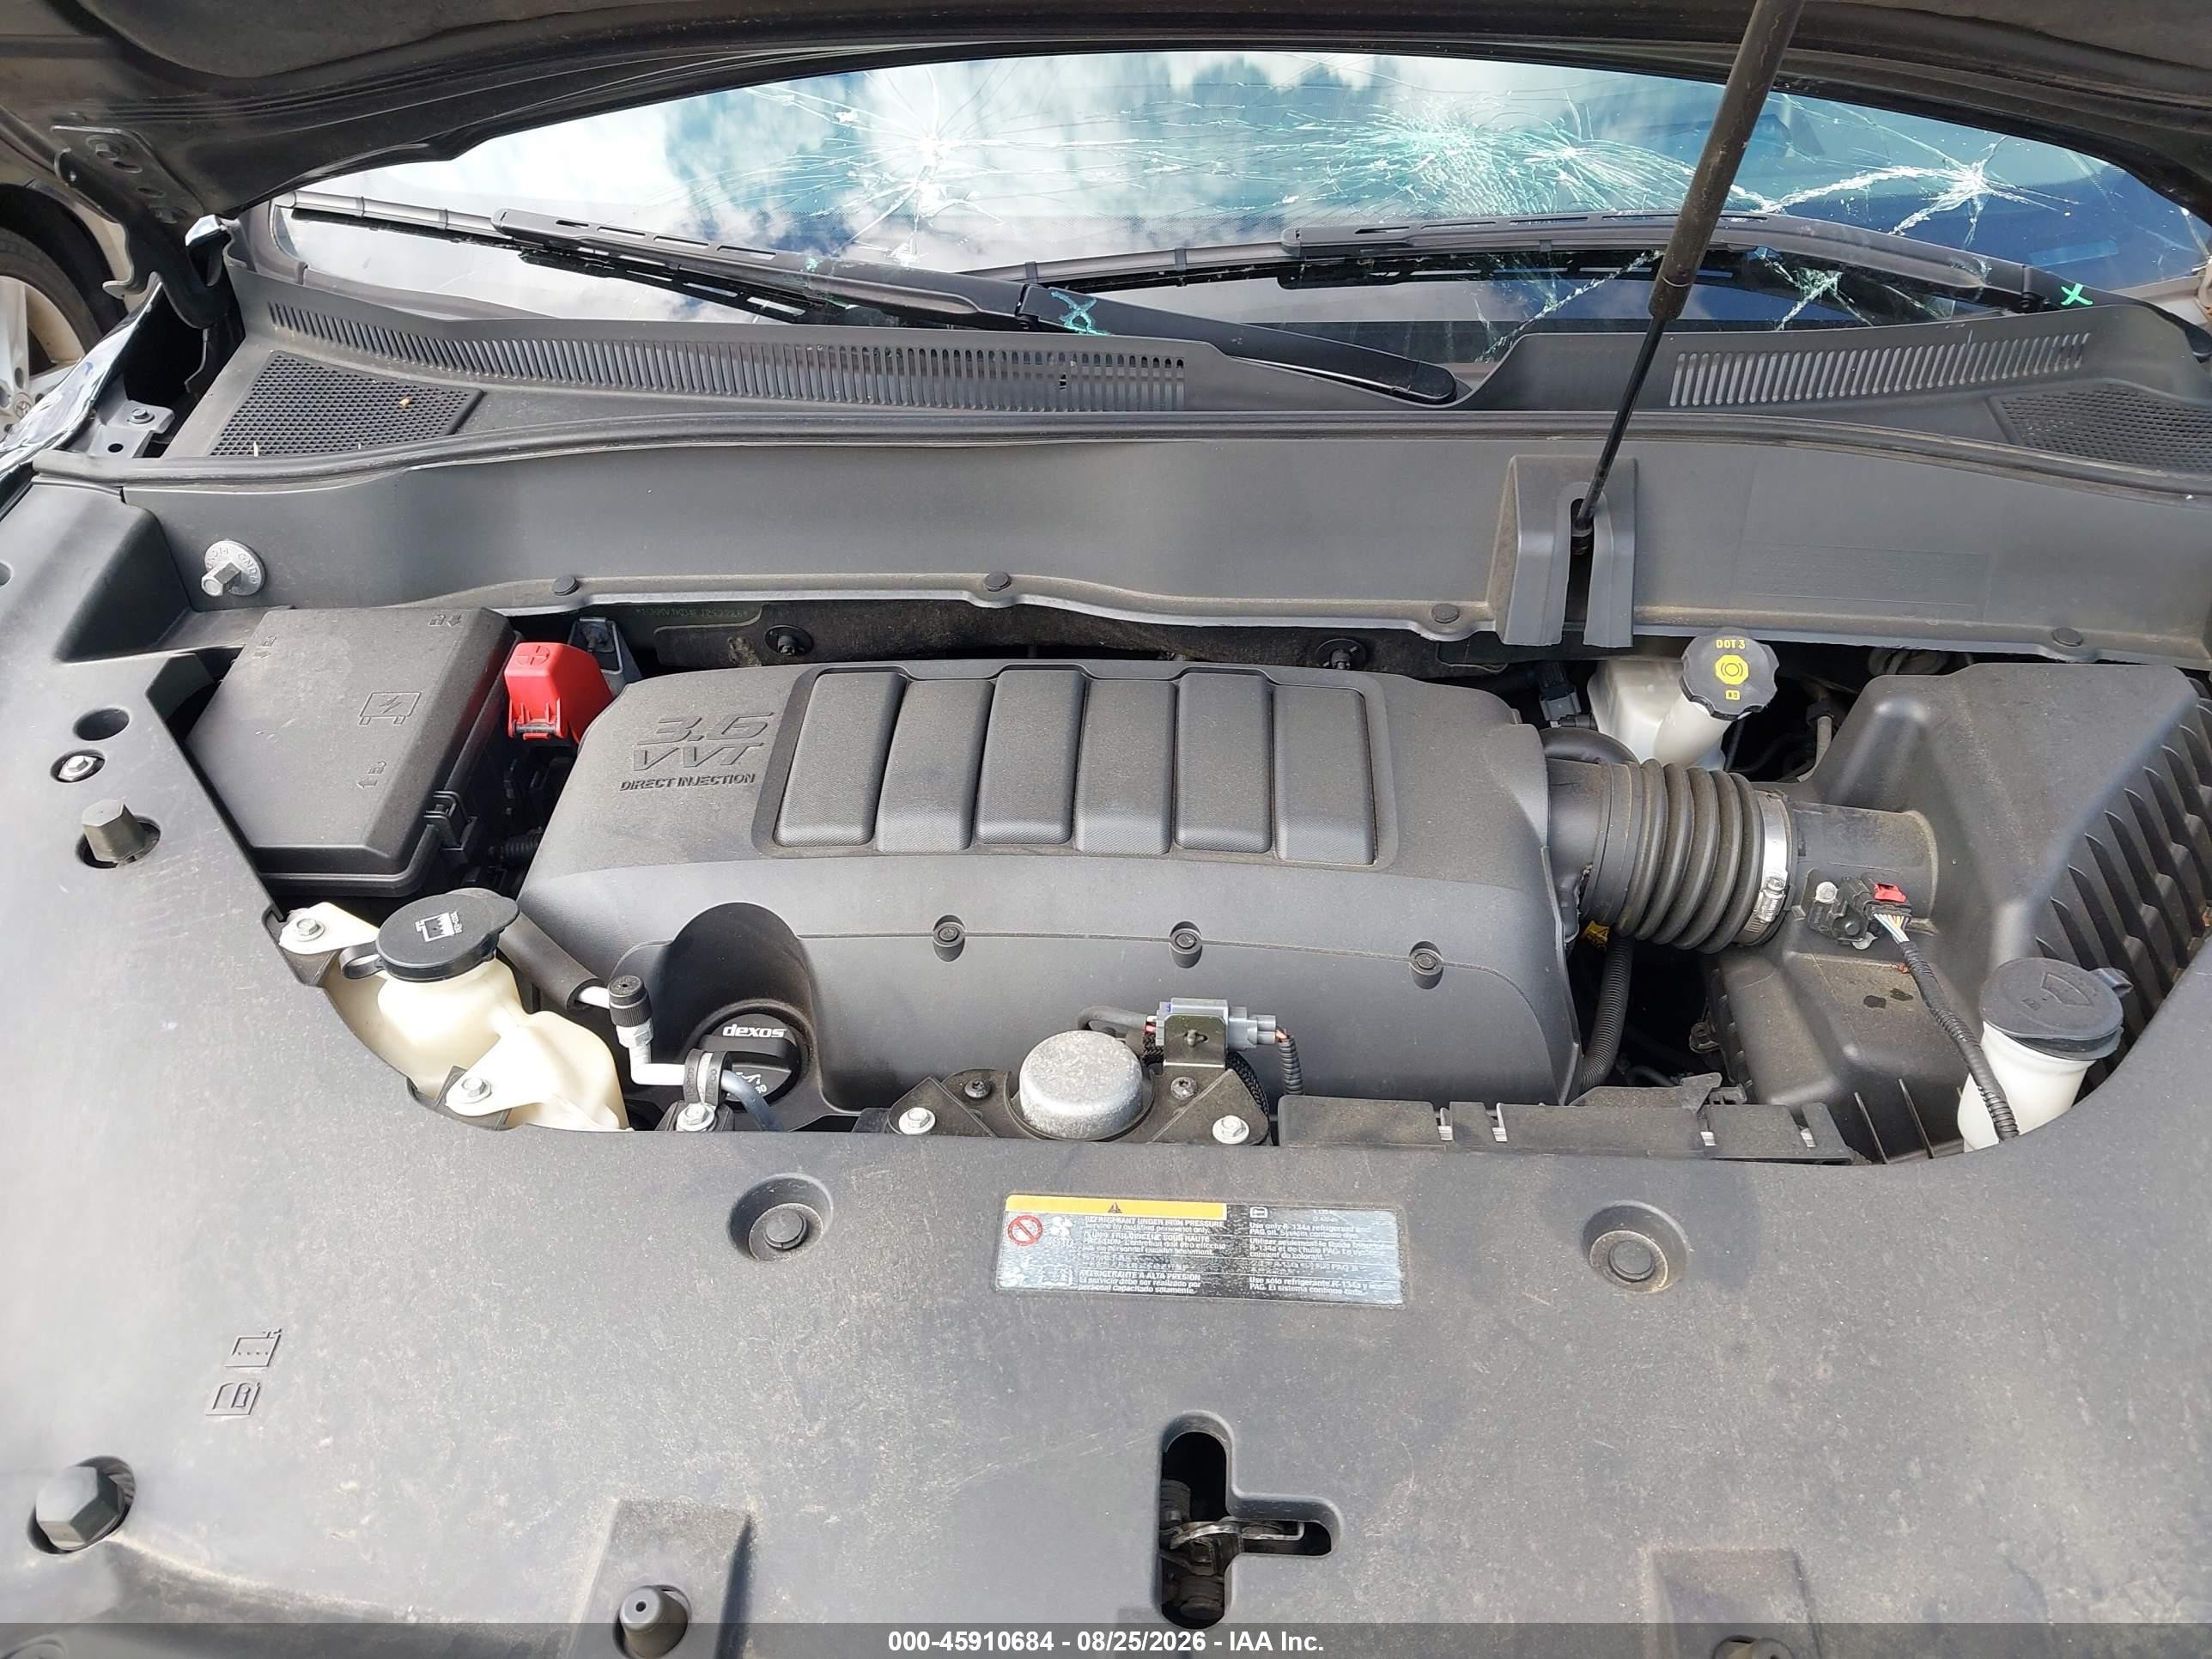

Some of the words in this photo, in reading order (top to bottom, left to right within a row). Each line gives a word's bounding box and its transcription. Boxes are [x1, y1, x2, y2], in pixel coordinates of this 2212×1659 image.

[1716, 640, 1736, 648] DOT
[1738, 639, 1746, 649] 3
[638, 712, 774, 745] 3.6
[633, 743, 764, 771] VVT
[619, 777, 675, 791] DIRECT
[677, 774, 756, 787] INJECTION
[722, 1024, 787, 1038] dexos
